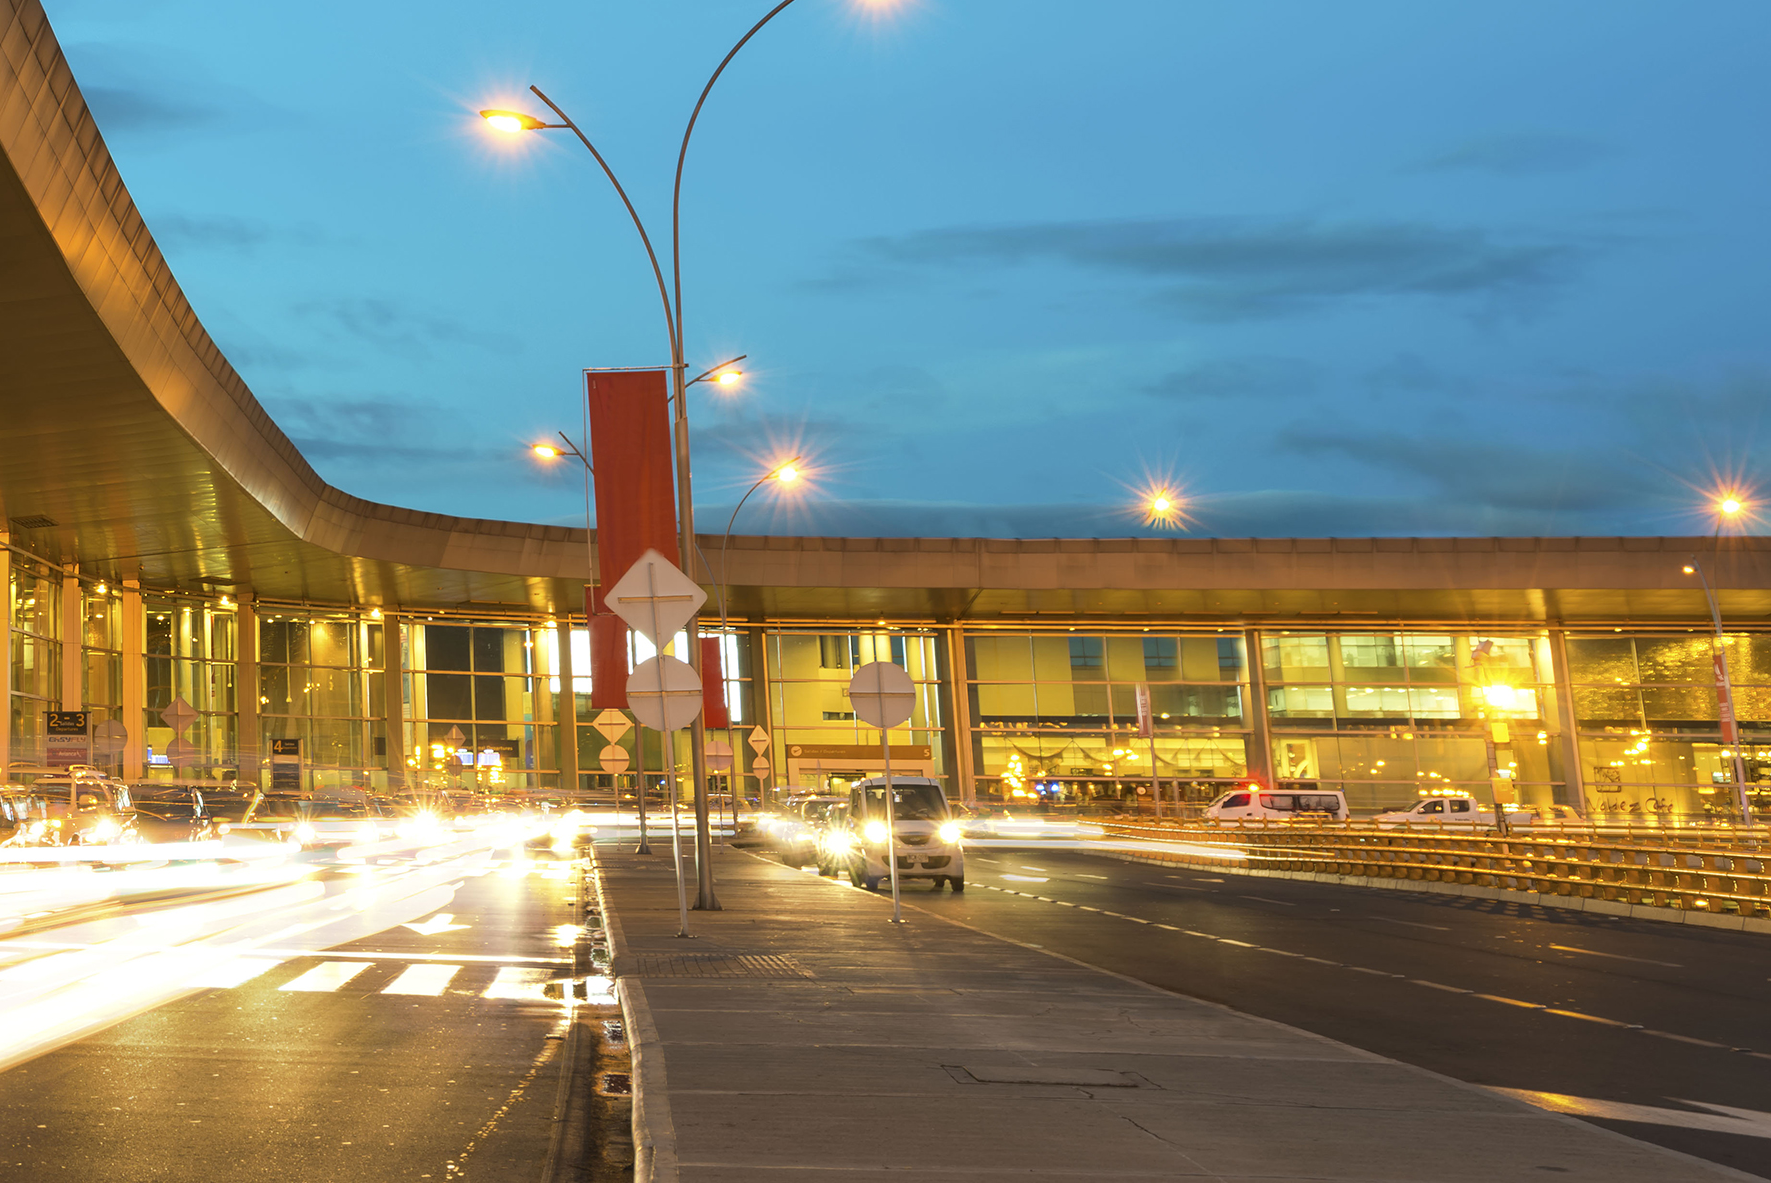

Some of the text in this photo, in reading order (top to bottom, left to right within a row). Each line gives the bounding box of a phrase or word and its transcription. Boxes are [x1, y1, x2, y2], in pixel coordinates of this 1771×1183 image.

[76, 713, 85, 727] 3
[273, 740, 284, 753] 4
[923, 748, 930, 757] 5
